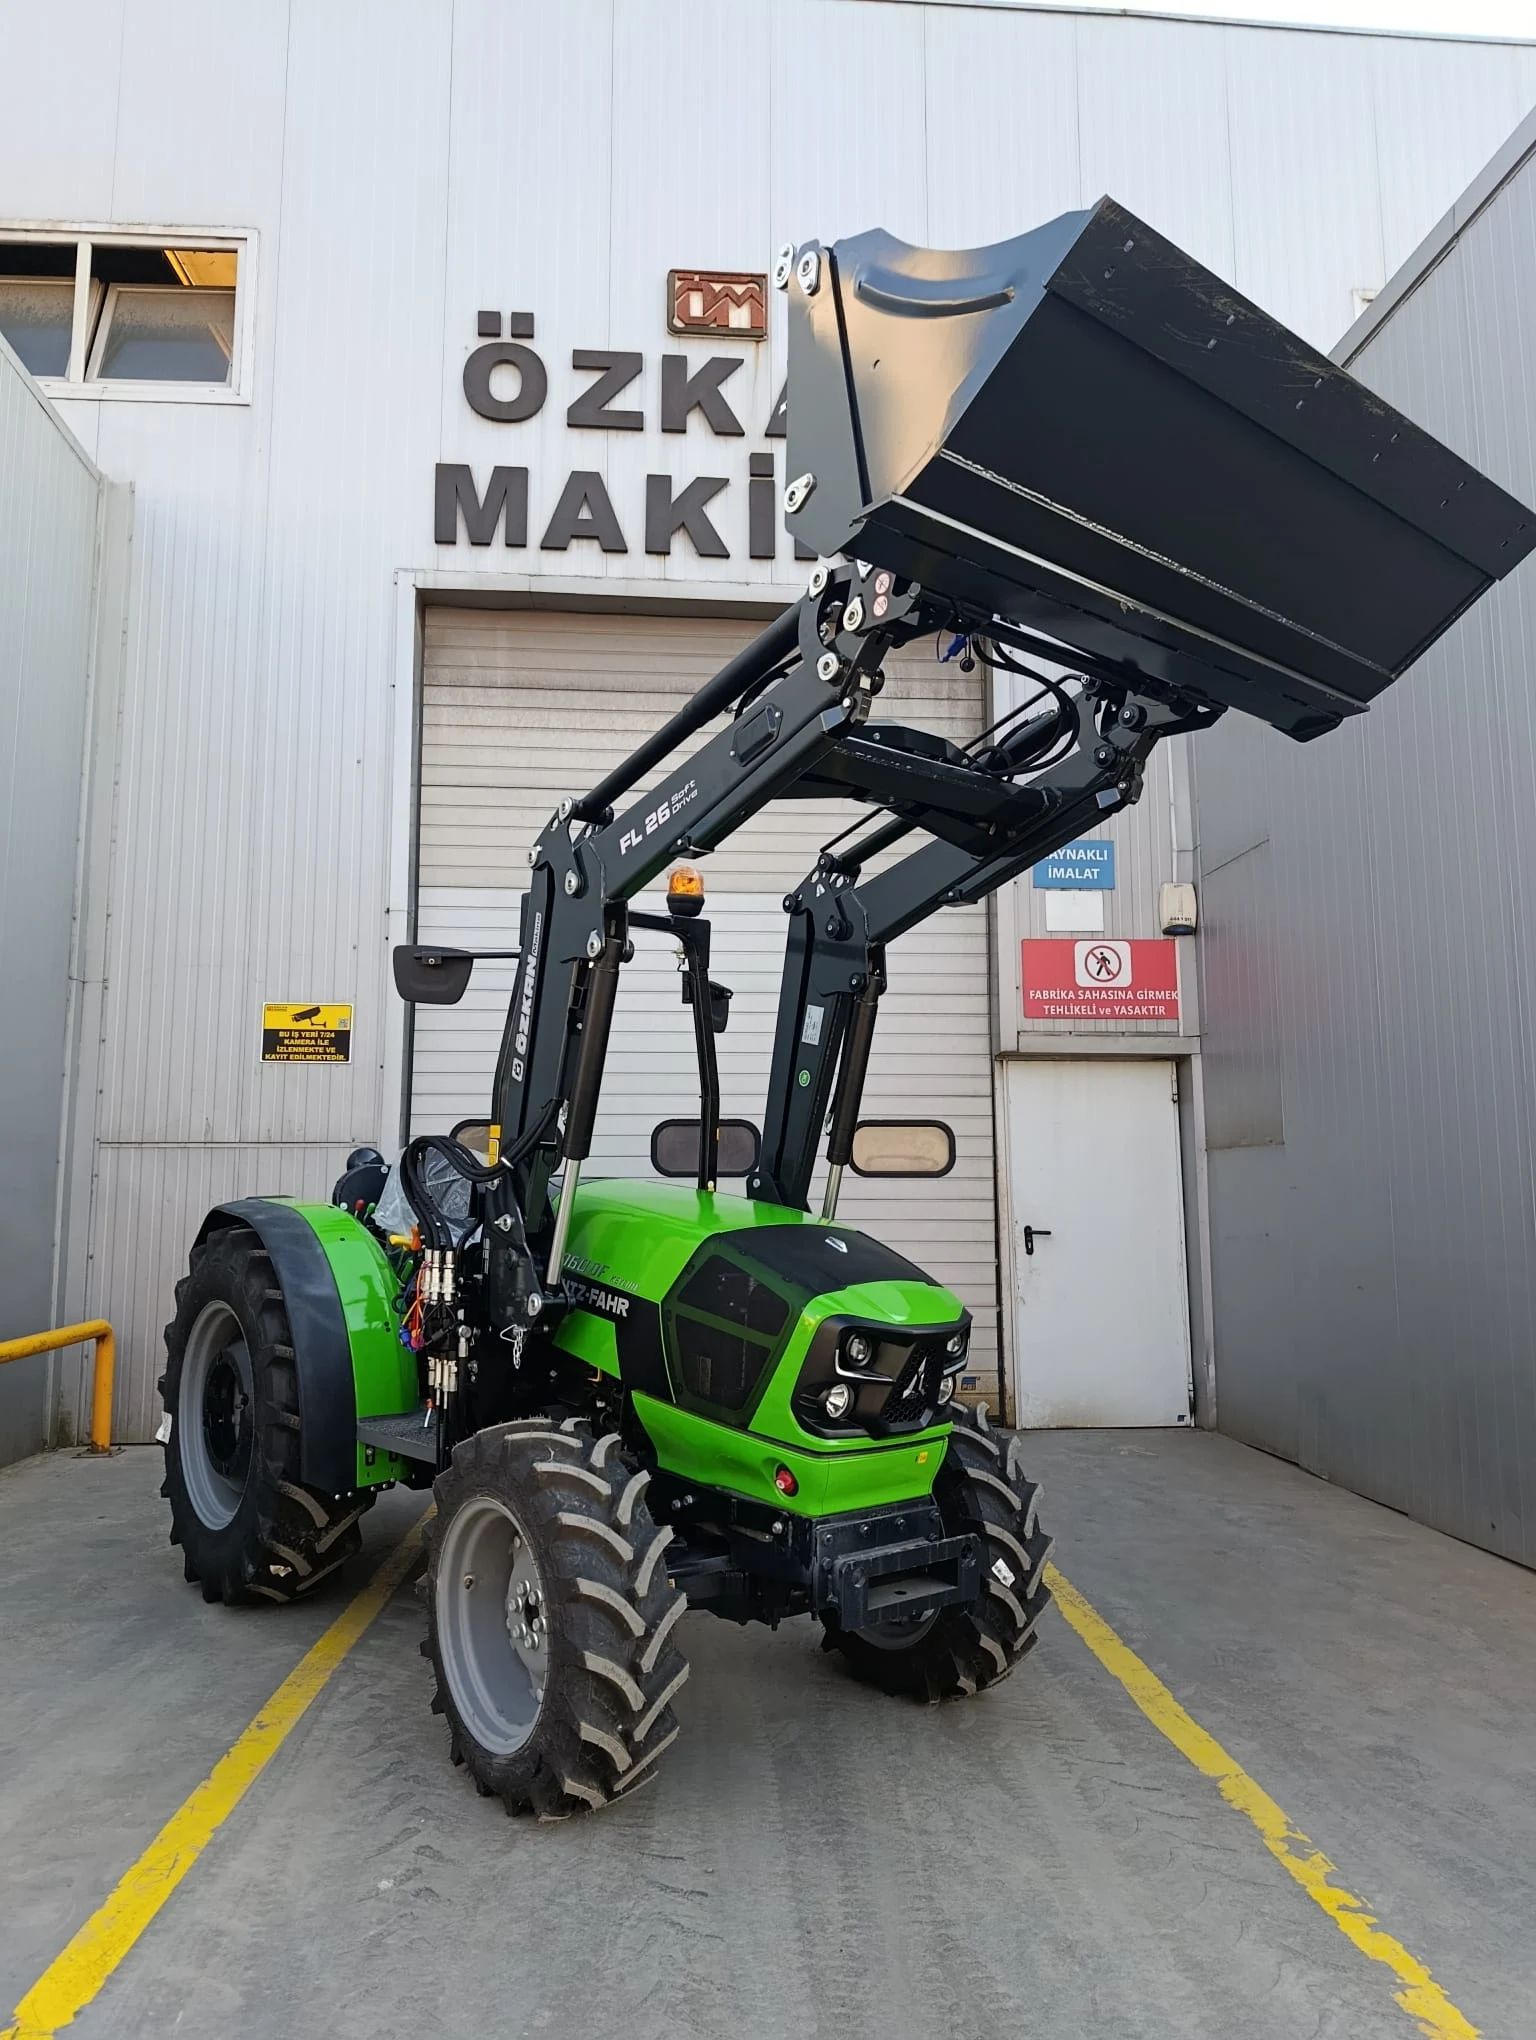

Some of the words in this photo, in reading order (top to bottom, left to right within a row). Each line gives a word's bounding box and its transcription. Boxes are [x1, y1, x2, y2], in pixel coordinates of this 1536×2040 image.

[462, 310, 788, 437] ÖZK
[434, 452, 818, 561] MAKİ
[671, 779, 696, 805] Soft
[671, 788, 698, 815] Drive
[619, 828, 643, 856] FL
[644, 801, 671, 836] 26
[1043, 849, 1108, 861] AYNAKLI
[1048, 865, 1100, 880] İMALAT
[1029, 989, 1075, 1000] FABRİKA
[1077, 989, 1134, 1001] SAHASINA
[1136, 989, 1179, 1001] GİRMEK
[1043, 1004, 1097, 1016] TEHLİKELİ
[1098, 1006, 1112, 1016] ve
[1113, 1005, 1166, 1016] YASAKTIR
[276, 1045, 325, 1053] İZLENMEKTE
[317, 1038, 330, 1046] İLE
